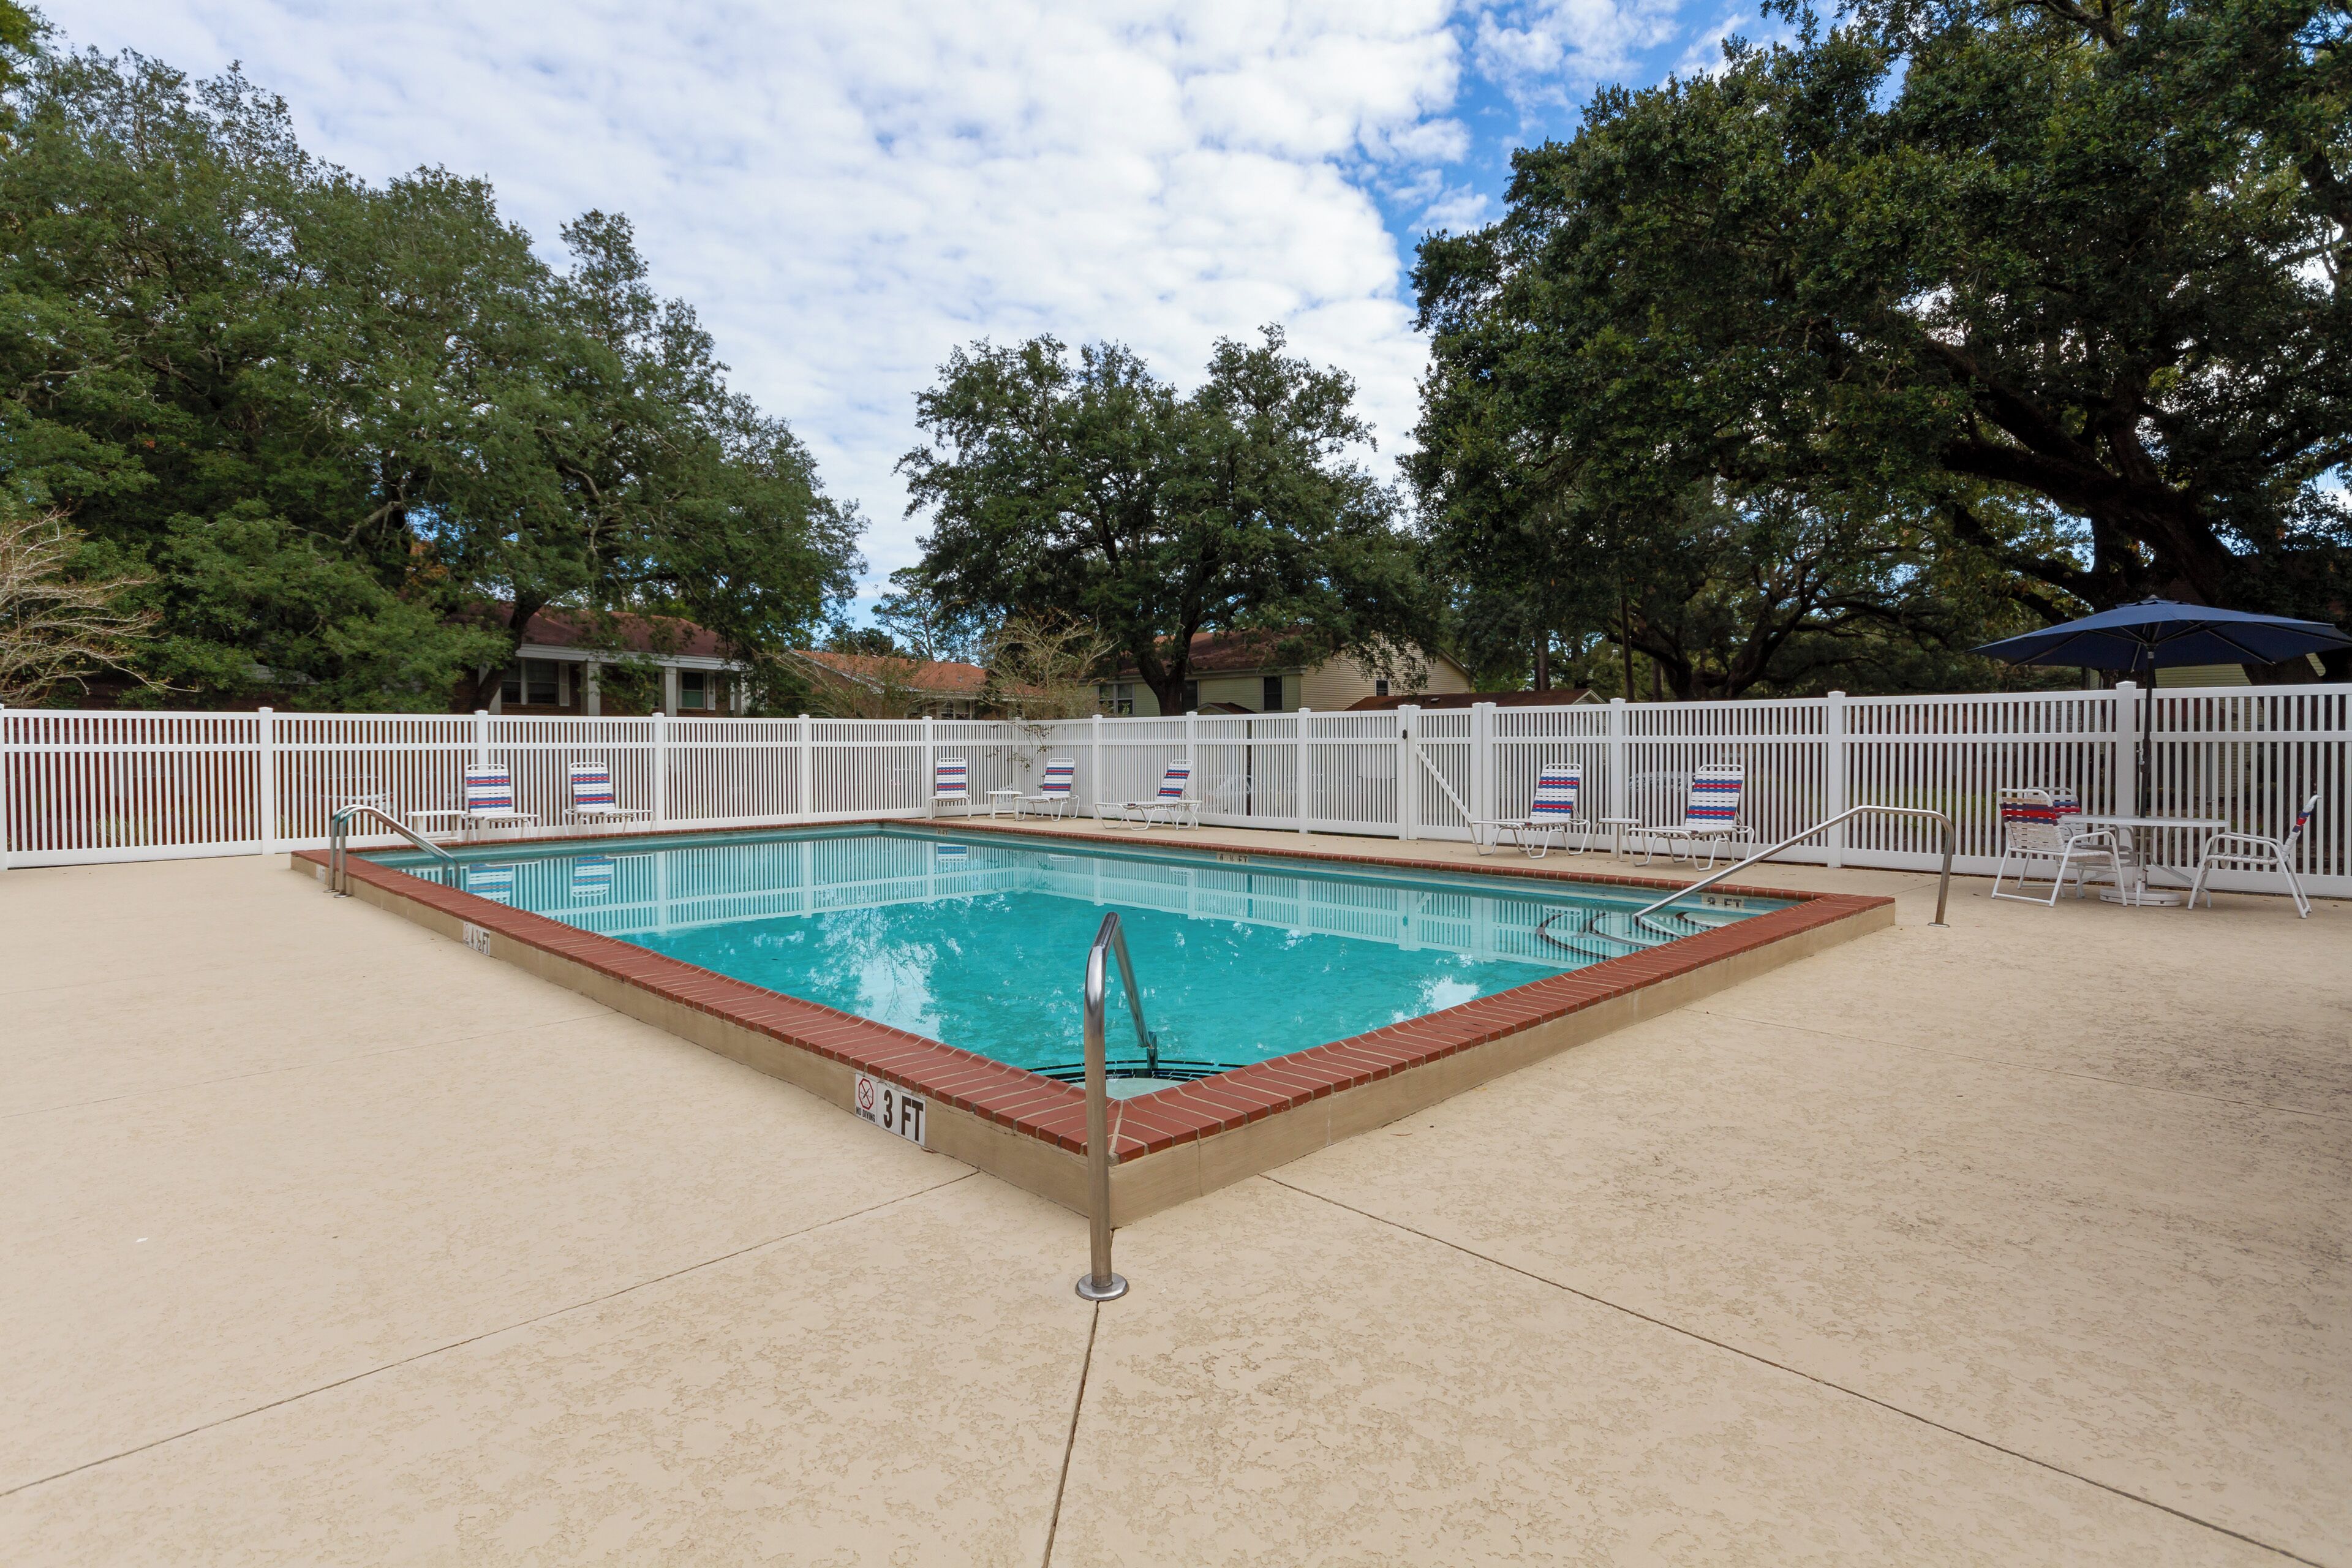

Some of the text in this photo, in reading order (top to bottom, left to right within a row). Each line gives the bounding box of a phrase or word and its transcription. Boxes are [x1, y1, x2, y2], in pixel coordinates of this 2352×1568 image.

[482, 932, 489, 954] FT
[856, 1106, 876, 1122] NO DIVING
[883, 1090, 924, 1142] 3 FT
